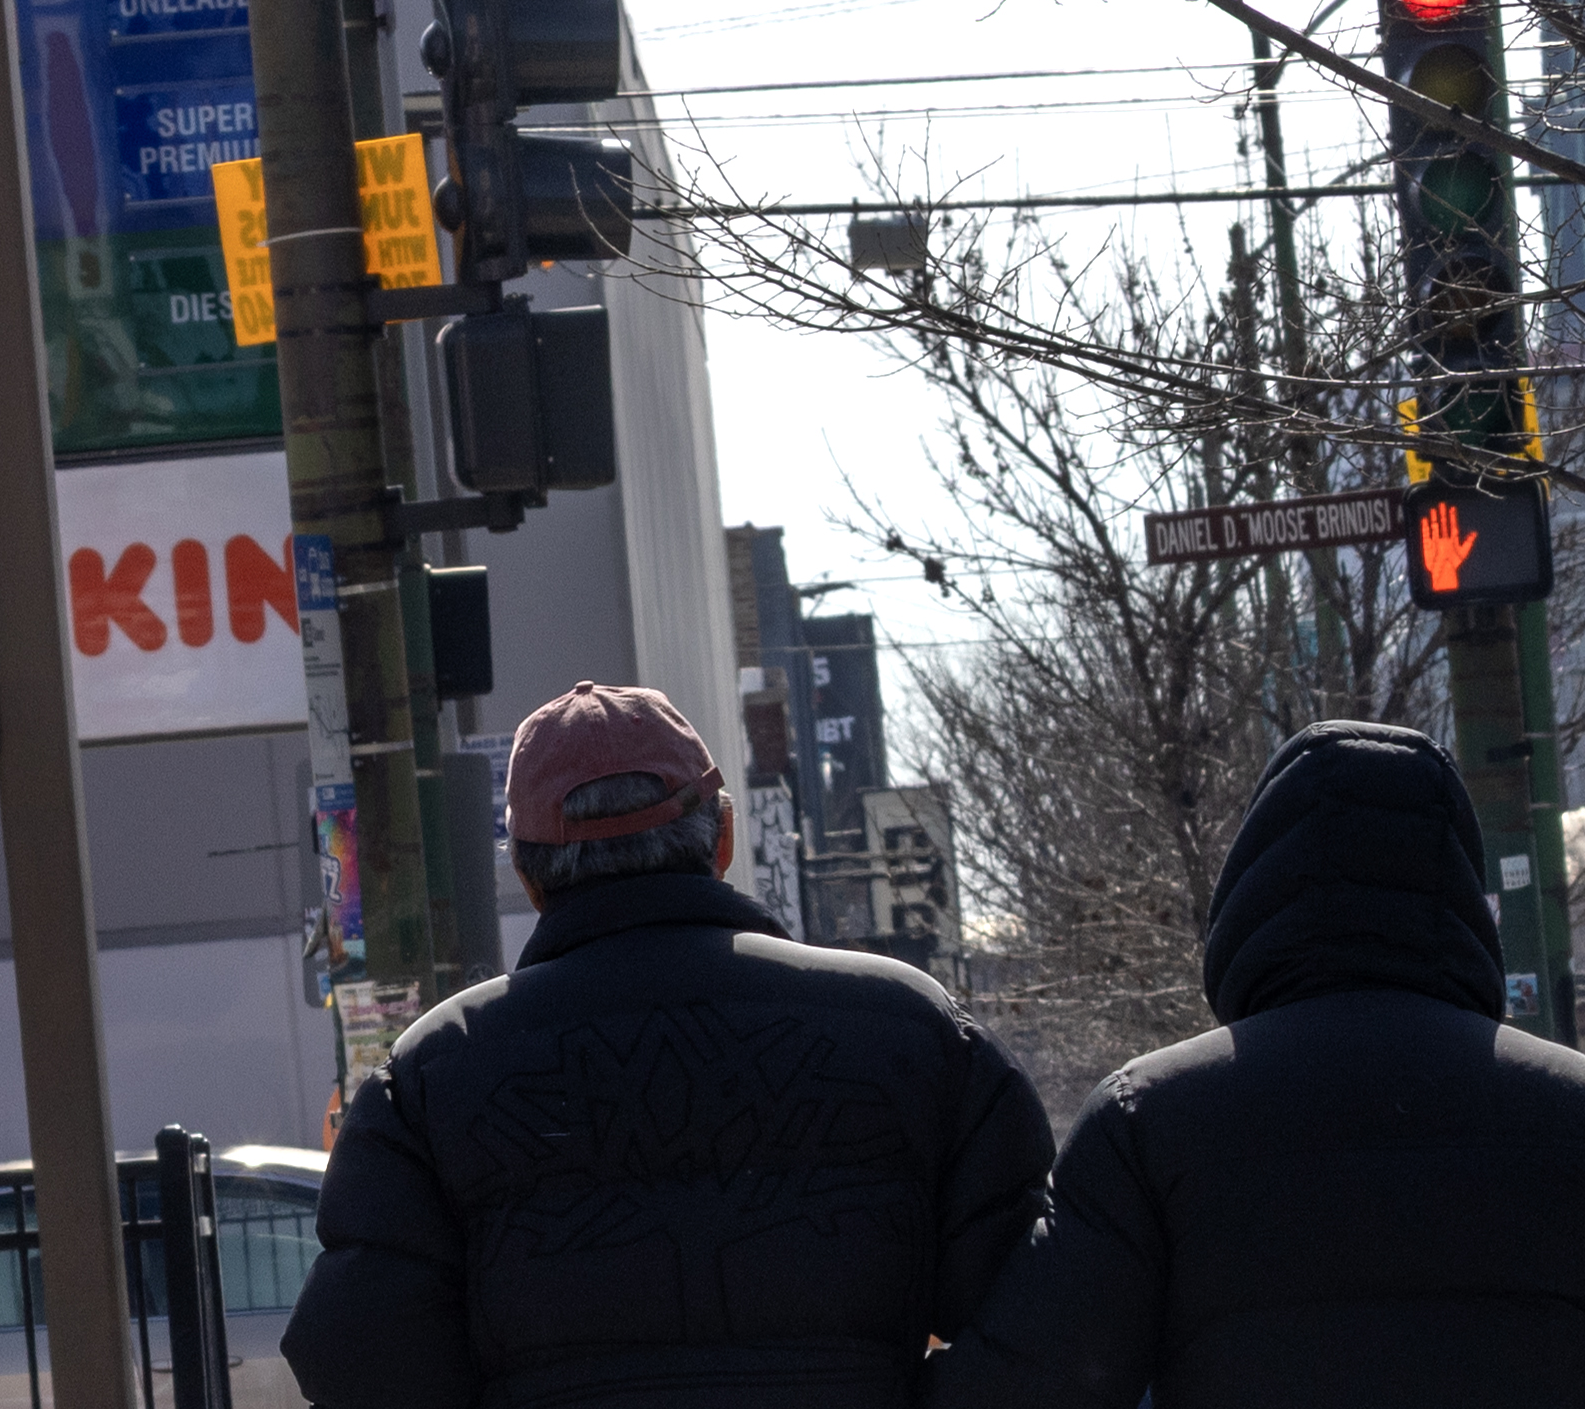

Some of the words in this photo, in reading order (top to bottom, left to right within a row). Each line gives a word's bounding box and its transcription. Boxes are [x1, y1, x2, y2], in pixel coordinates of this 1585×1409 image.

[157, 102, 254, 137] SUPER
[170, 292, 234, 324] DIES
[1156, 515, 1218, 556] DANIEL
[1224, 514, 1242, 548] D.
[1316, 498, 1391, 539] BRINDISI
